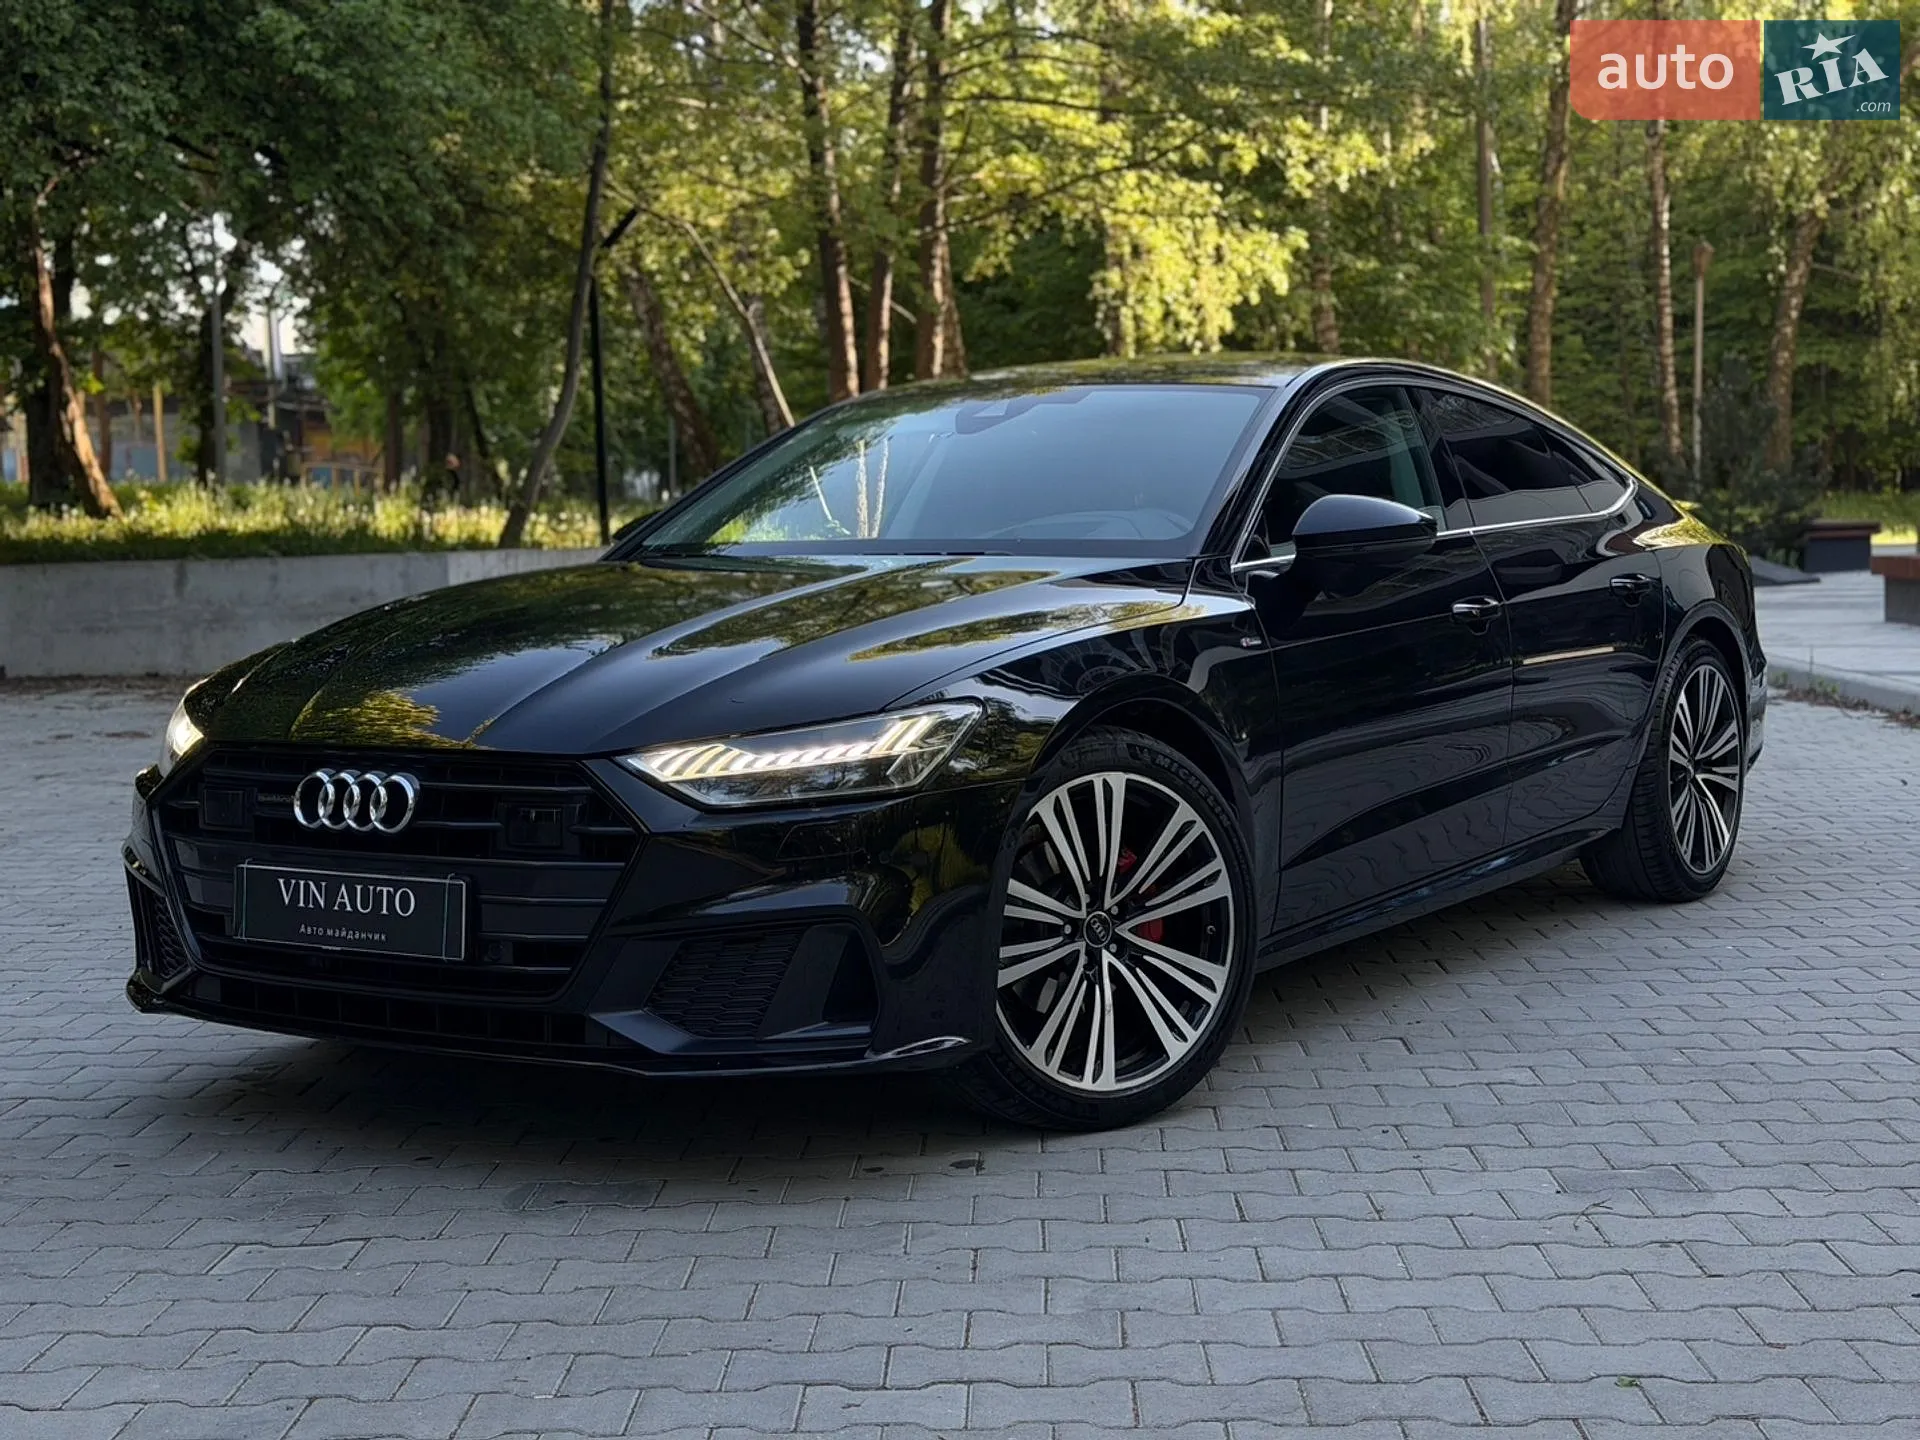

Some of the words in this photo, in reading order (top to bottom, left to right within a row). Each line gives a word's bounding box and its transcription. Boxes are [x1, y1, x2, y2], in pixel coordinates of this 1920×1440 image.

[279, 879, 326, 908] VIN
[334, 884, 416, 916] AUTO
[300, 924, 323, 937] Авто
[327, 927, 387, 941] майданчик
